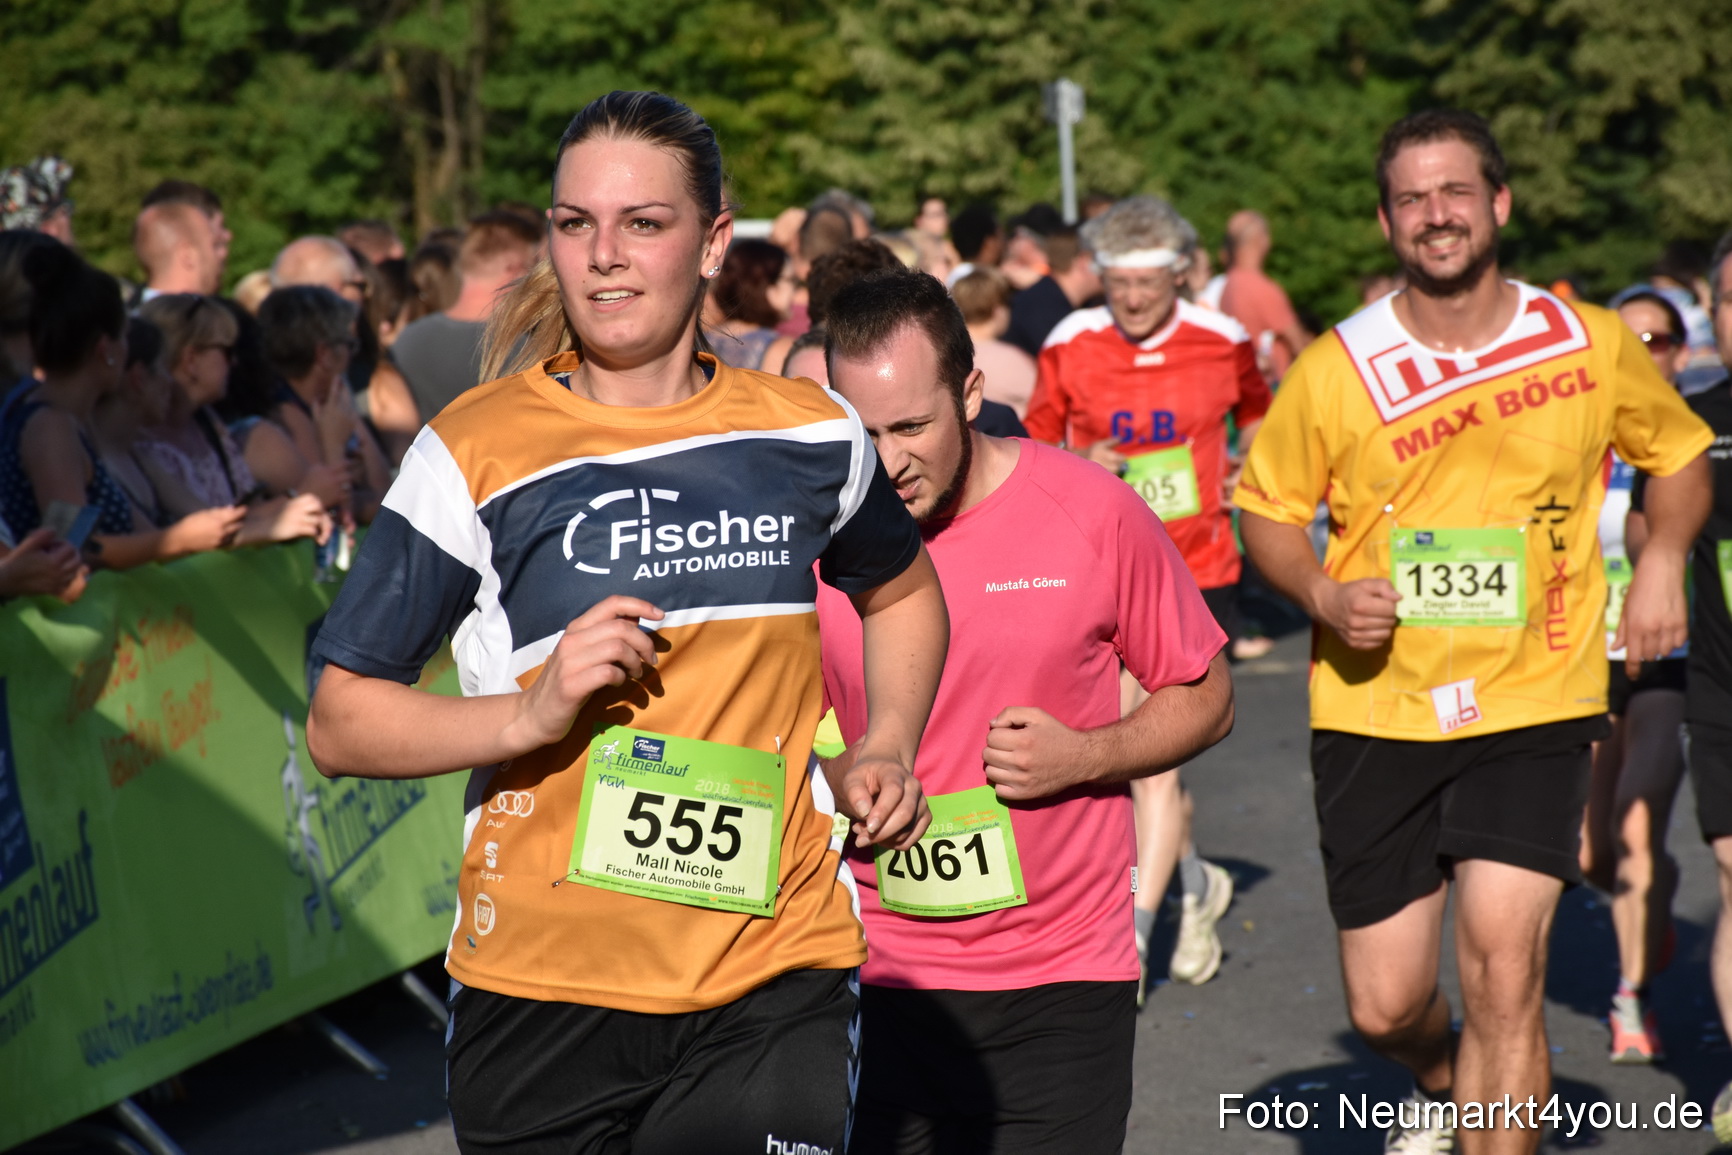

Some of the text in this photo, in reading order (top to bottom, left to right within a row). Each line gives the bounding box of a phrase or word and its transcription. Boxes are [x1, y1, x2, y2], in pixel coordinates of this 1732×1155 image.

[1390, 367, 1597, 465] MAX BÖGL
[1130, 474, 1177, 503] 05
[610, 510, 795, 560] Fischer
[633, 550, 790, 581] AUTOMOBILE
[1406, 563, 1508, 597] 1334
[985, 577, 1067, 593] Mustafa Gören
[615, 766, 647, 776] neumarkt
[616, 752, 690, 777] firmenlauf
[694, 779, 731, 795] 2018
[623, 791, 744, 862] 555
[606, 864, 745, 895] Fischer Automobile GmbH
[636, 853, 723, 879] Mall Nicole
